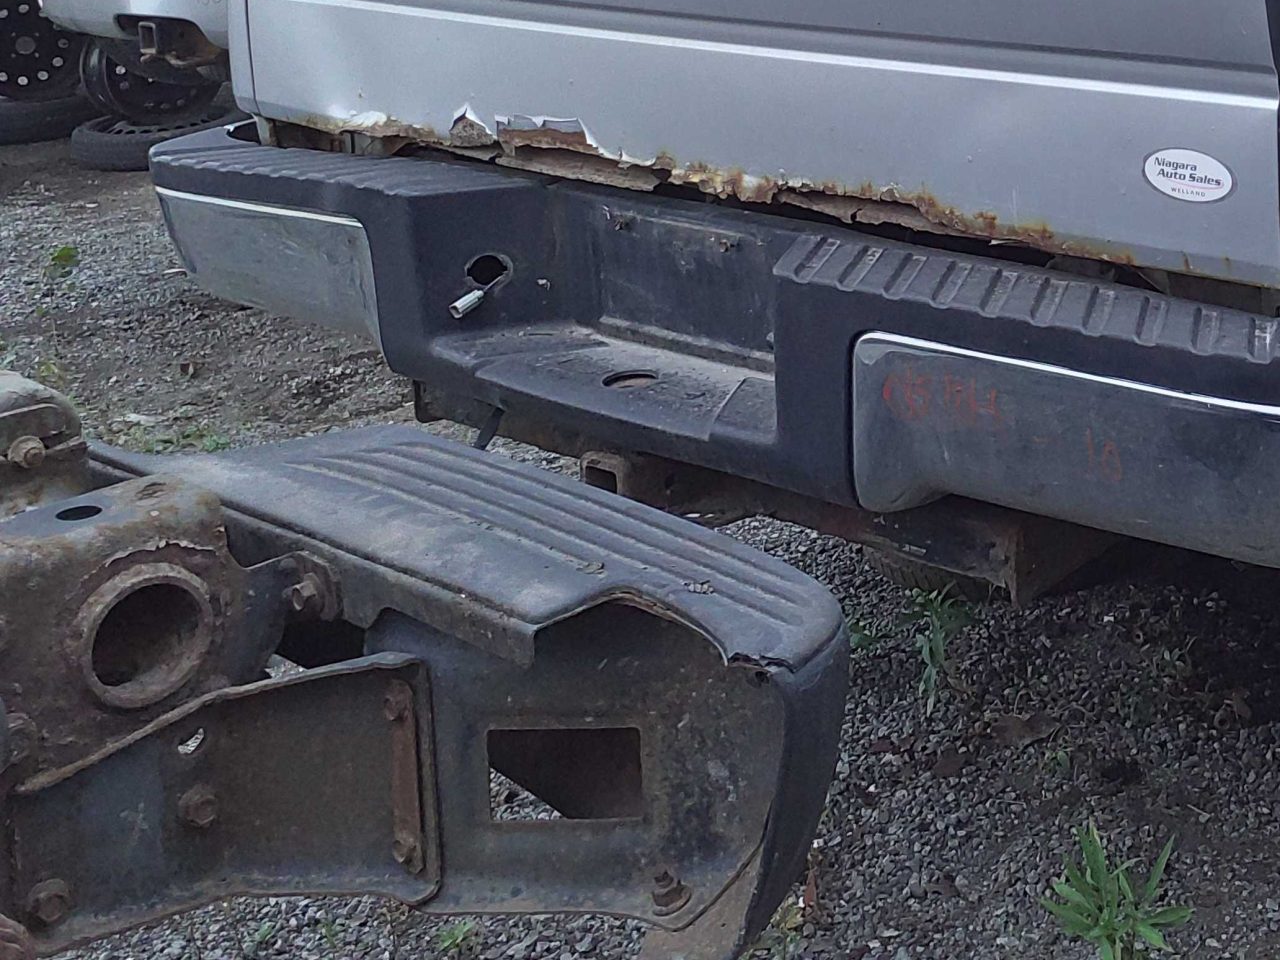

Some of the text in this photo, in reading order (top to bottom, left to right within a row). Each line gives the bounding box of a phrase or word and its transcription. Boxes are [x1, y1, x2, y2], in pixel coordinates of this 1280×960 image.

[1154, 156, 1197, 172] Niagara
[1157, 168, 1222, 186] Auto Sales
[1170, 186, 1206, 198] WELLAND
